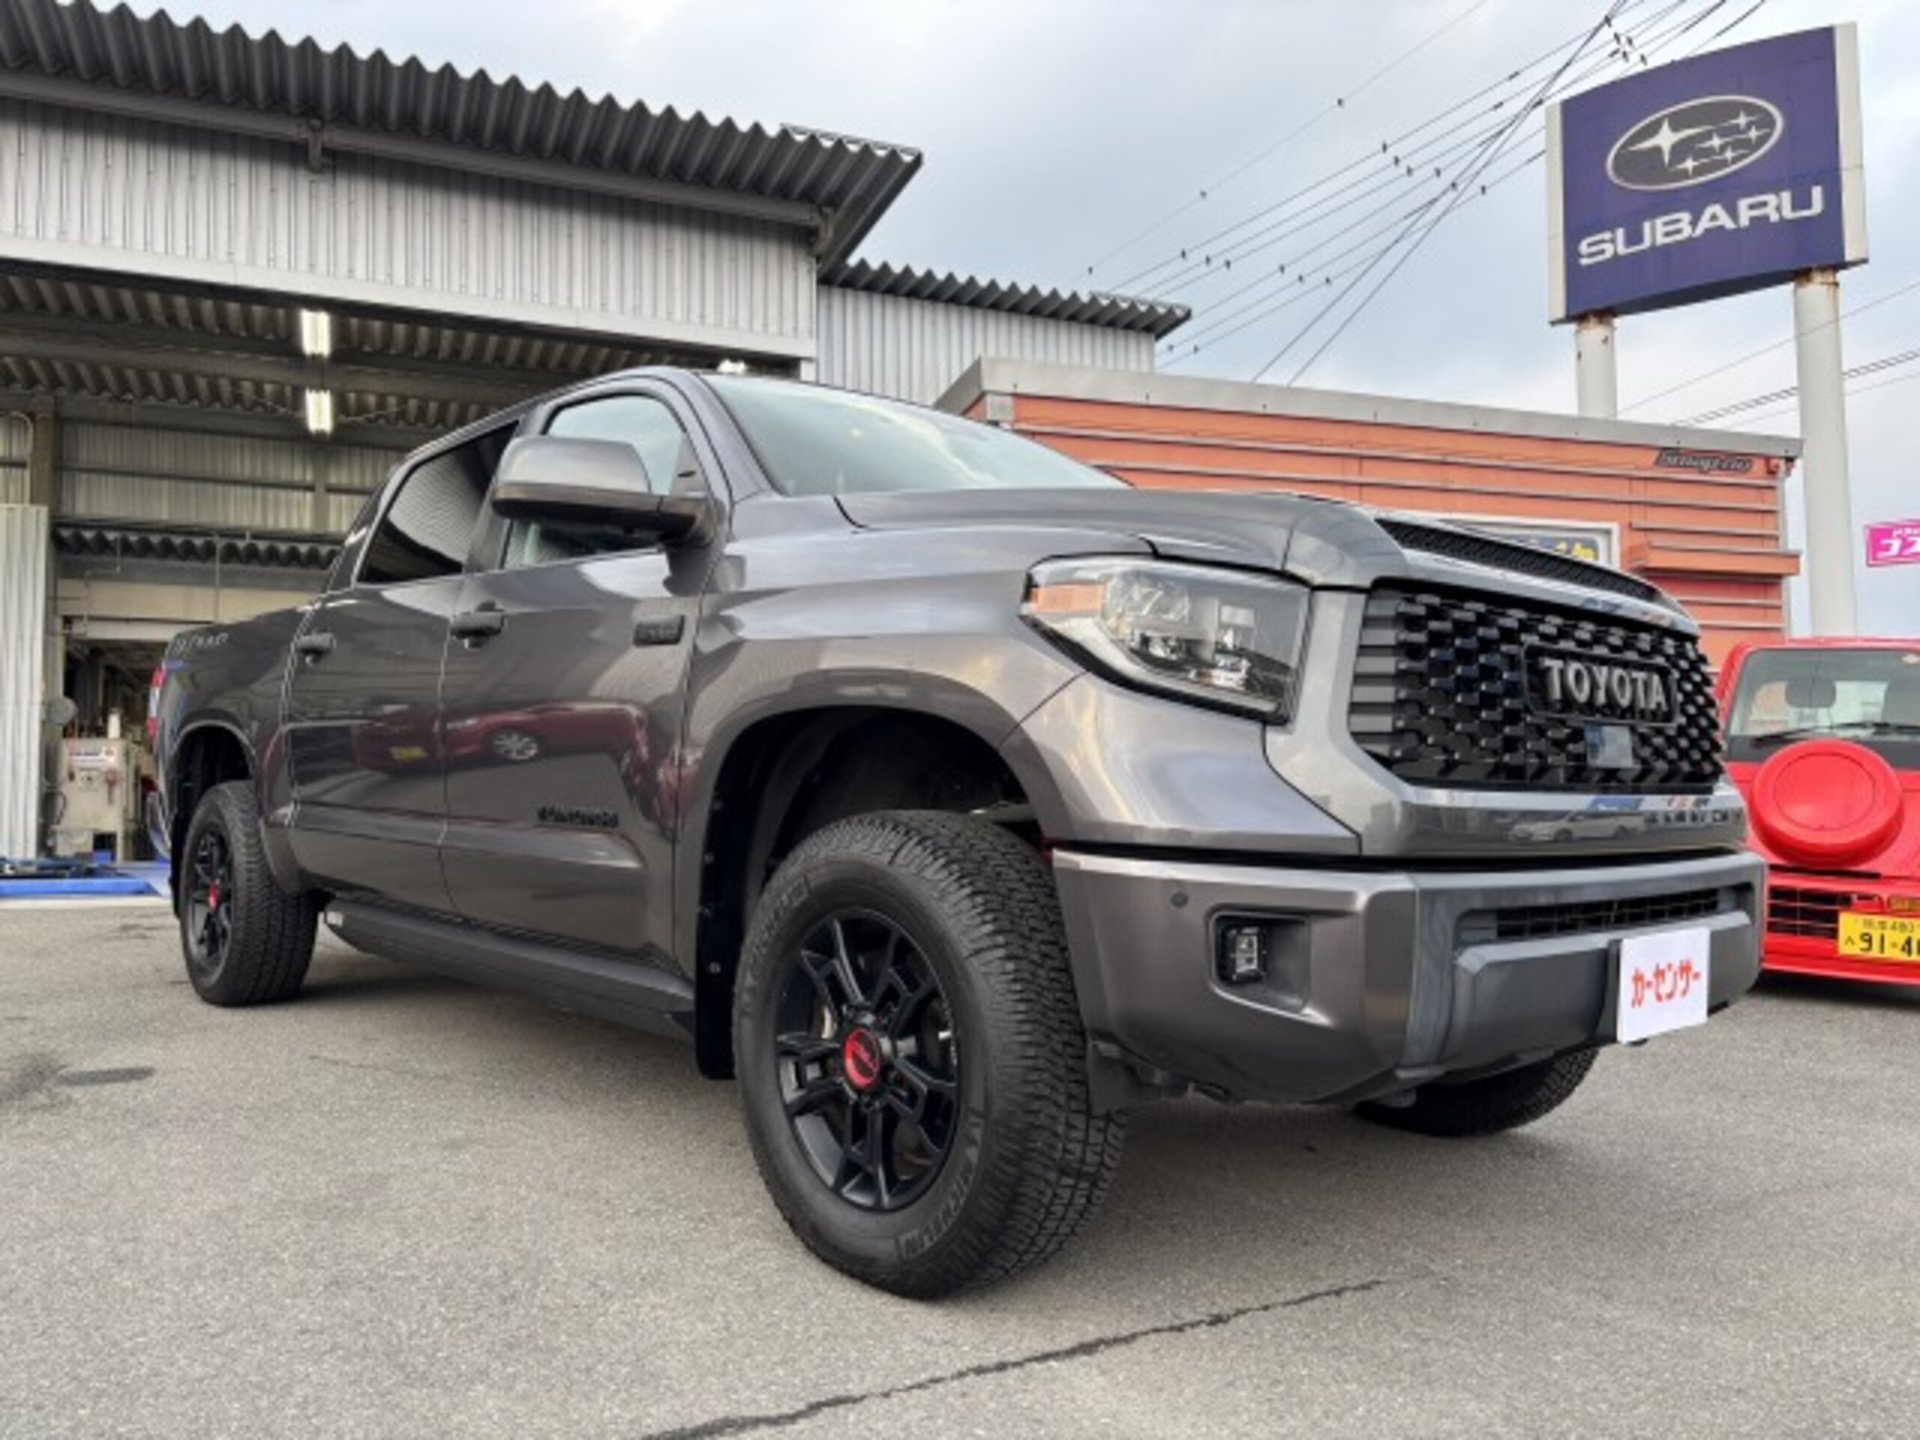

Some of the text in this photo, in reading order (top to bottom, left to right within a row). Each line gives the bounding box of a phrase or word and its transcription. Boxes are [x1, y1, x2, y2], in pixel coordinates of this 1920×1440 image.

[1578, 185, 1825, 266] SUBARU
[1539, 657, 1668, 712] TOYOTA
[1631, 958, 1702, 1008] カーセンサー
